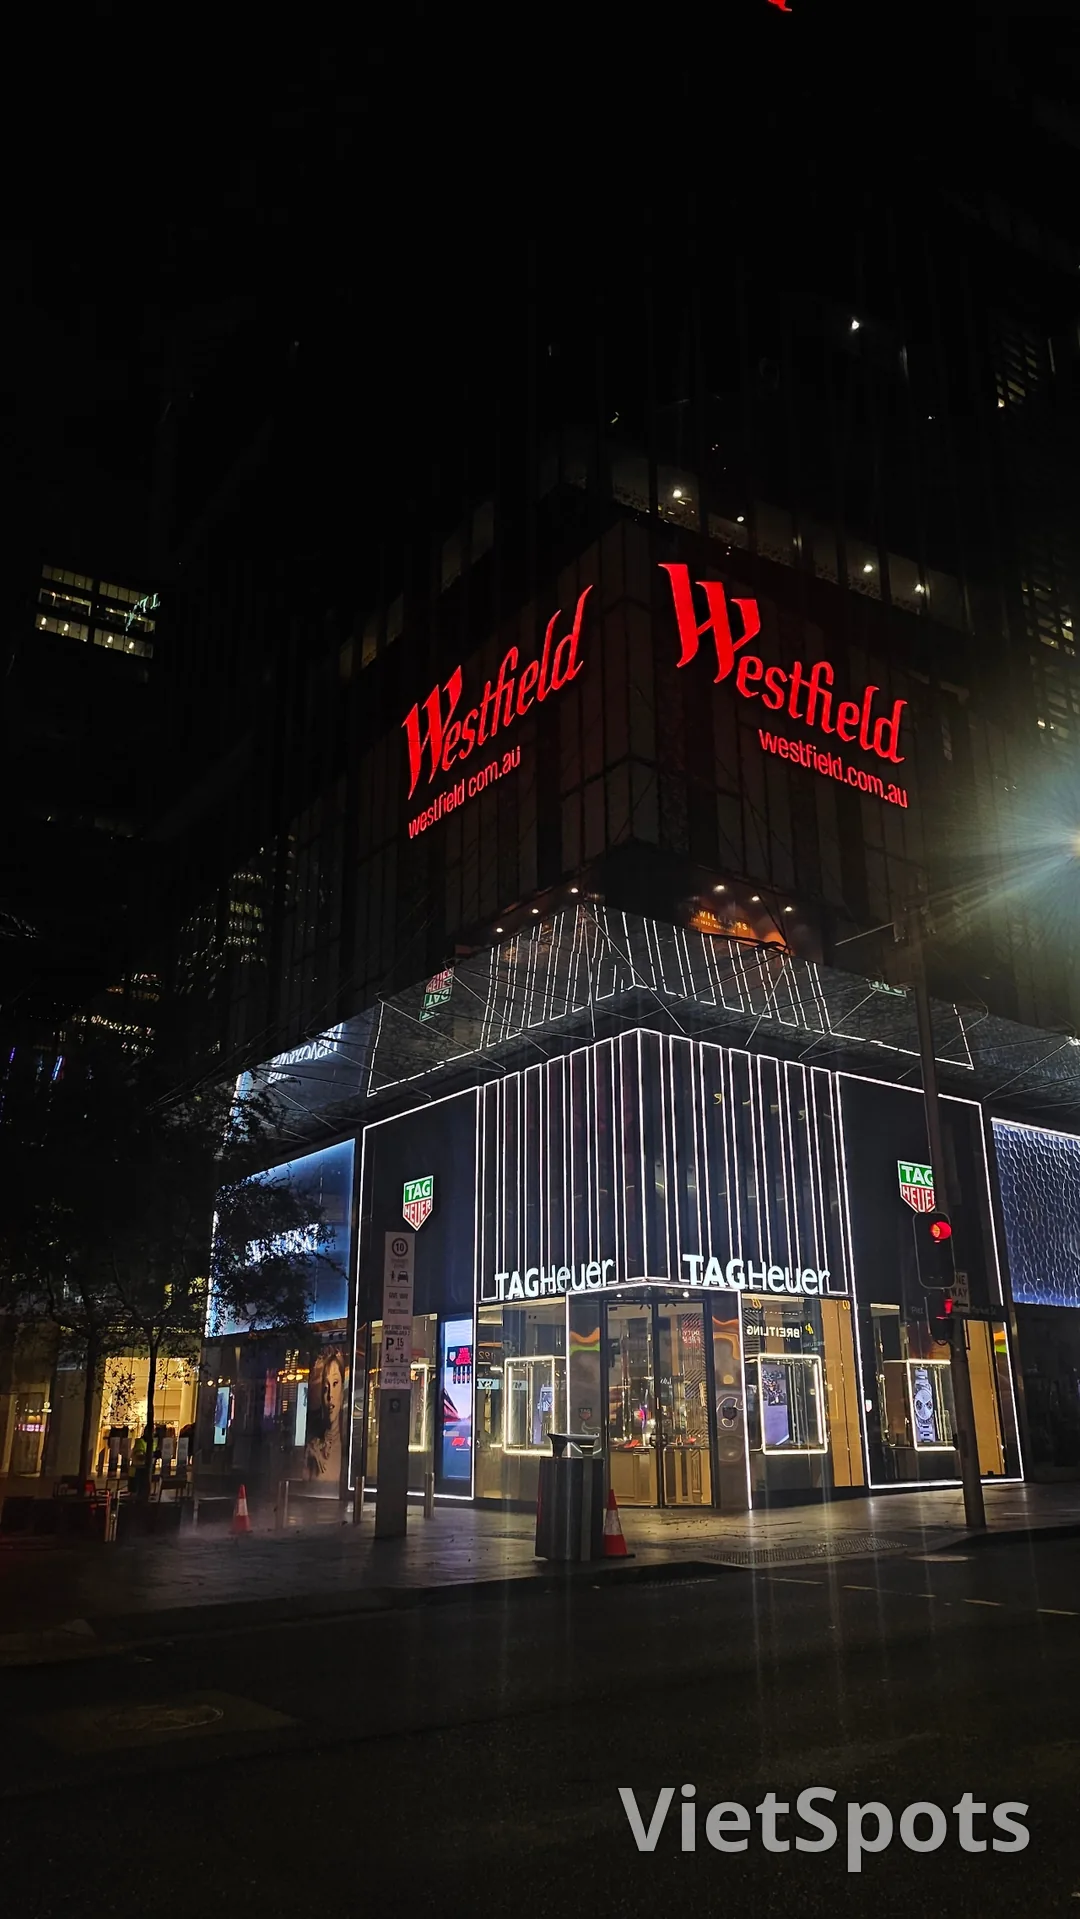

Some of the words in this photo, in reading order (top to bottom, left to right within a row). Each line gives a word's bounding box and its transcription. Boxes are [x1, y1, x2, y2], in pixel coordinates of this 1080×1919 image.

[658, 563, 908, 764] Westfield
[401, 584, 593, 799] Westfield
[758, 728, 908, 808] westfield.com.au
[408, 745, 521, 839] westfieldcom.au
[901, 1165, 934, 1187] TAG
[406, 1180, 431, 1201] TAG
[404, 1199, 431, 1227] HEUER
[395, 1242, 405, 1252] 10
[386, 1337, 394, 1350] P
